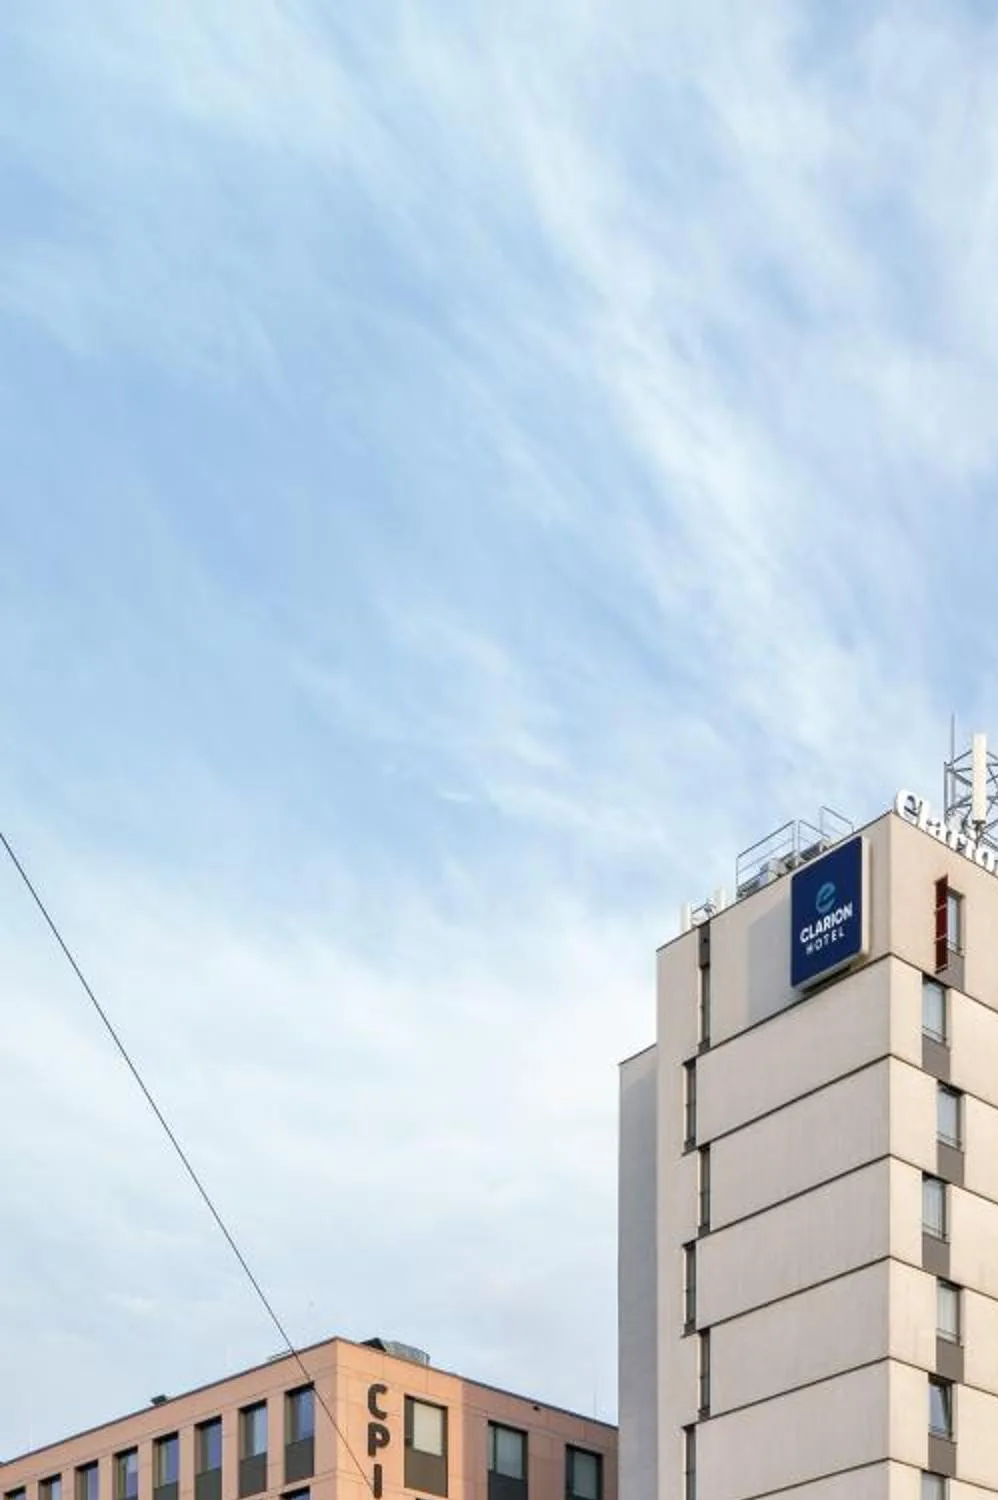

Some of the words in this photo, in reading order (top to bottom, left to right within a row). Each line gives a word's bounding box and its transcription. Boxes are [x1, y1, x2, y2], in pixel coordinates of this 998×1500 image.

[800, 902, 853, 943] CLARION
[806, 925, 845, 955] HOTEL
[367, 1383, 391, 1500] CPI
